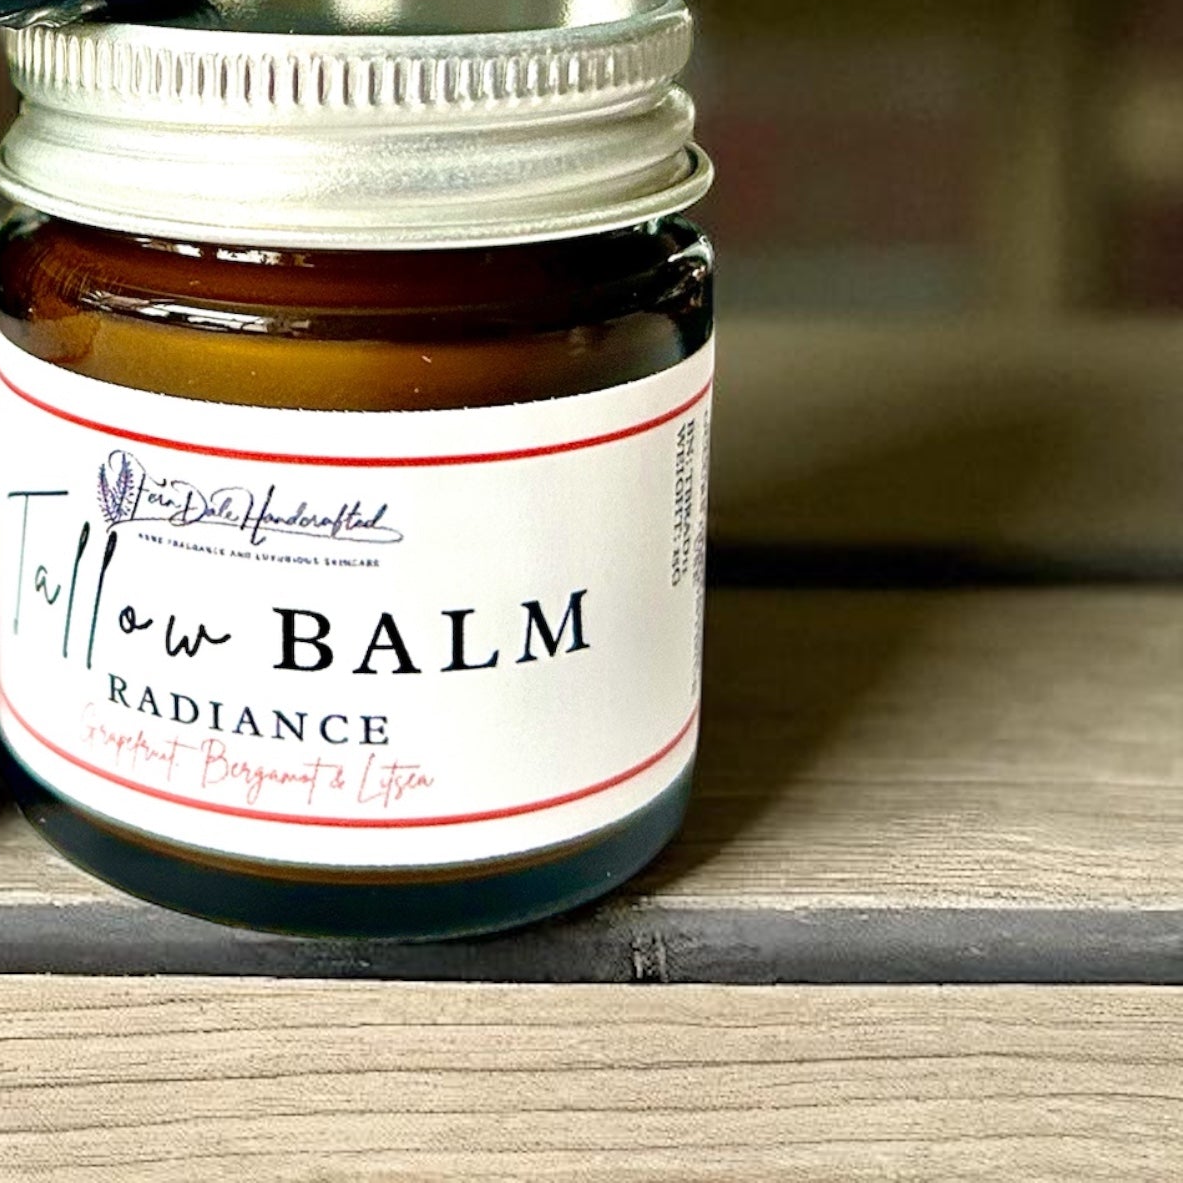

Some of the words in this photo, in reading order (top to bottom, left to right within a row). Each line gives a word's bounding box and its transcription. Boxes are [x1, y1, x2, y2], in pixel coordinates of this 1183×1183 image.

[211, 484, 389, 546] Handcrafted
[7, 490, 232, 670] Tallow
[273, 589, 590, 674] BALM
[107, 673, 390, 745] RADIANCE
[200, 738, 342, 805] Bergamot
